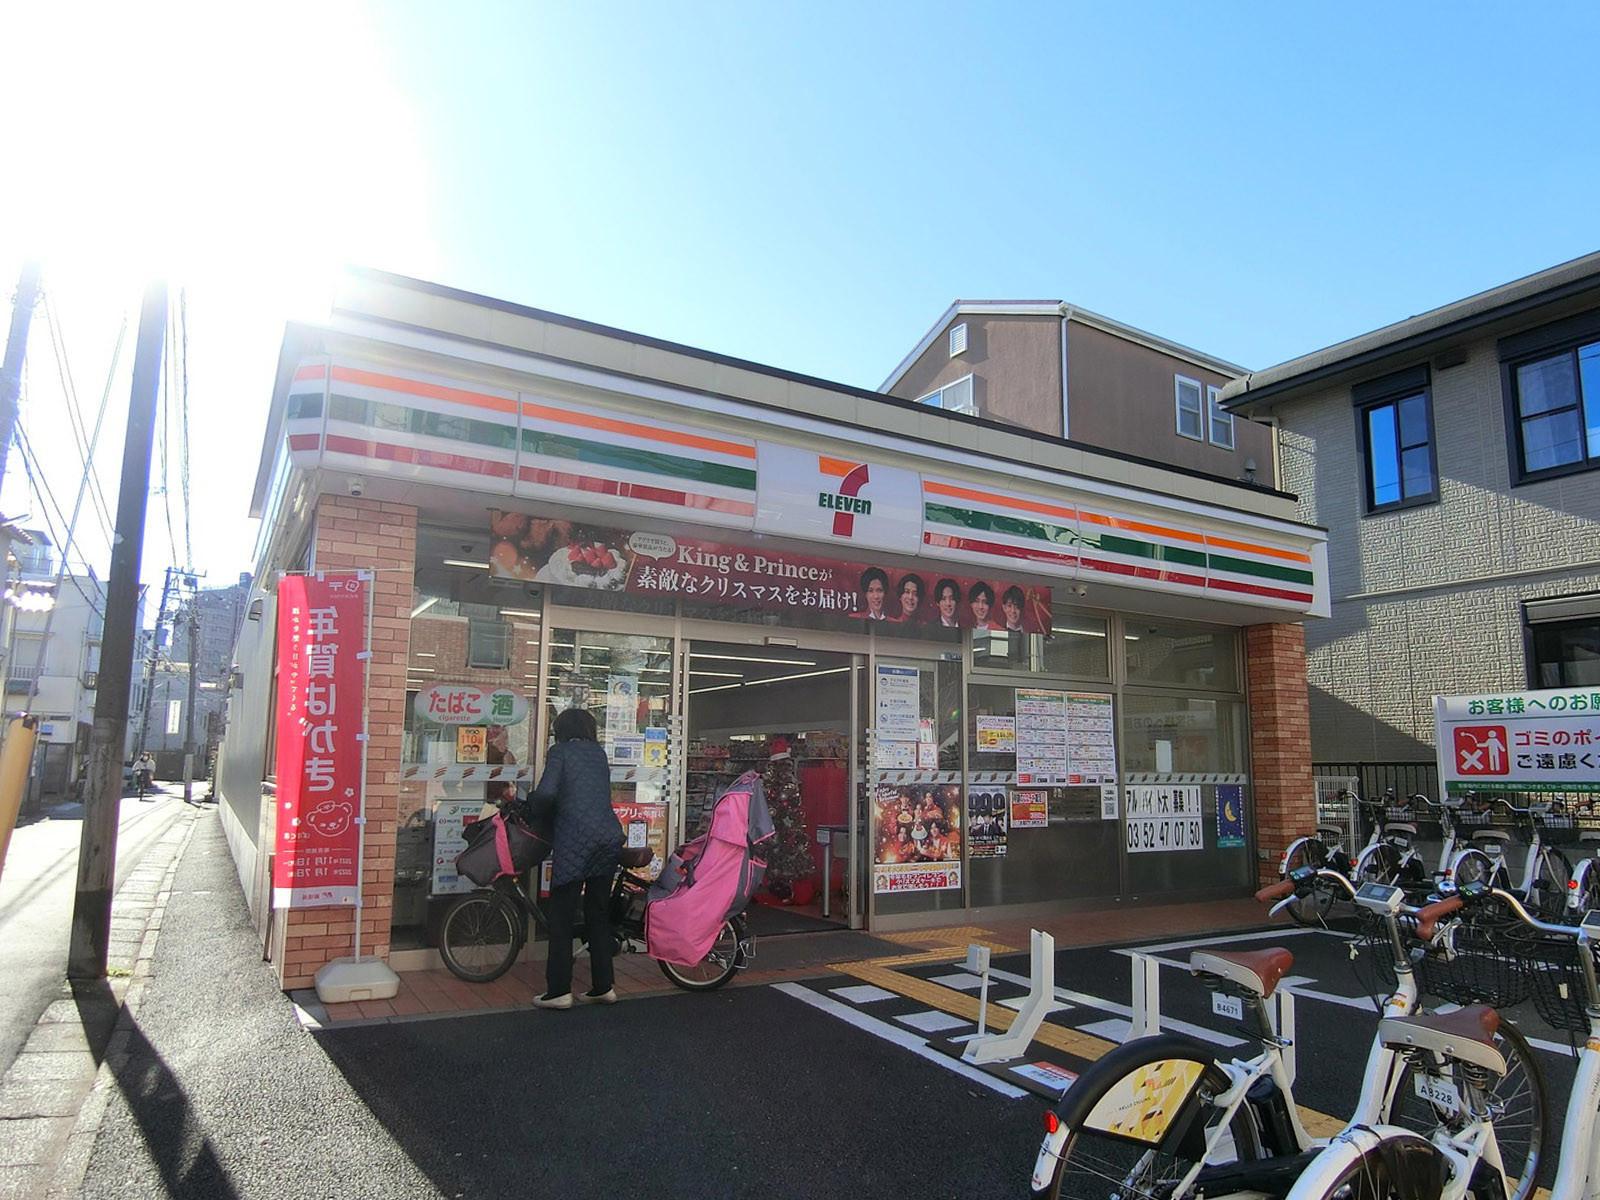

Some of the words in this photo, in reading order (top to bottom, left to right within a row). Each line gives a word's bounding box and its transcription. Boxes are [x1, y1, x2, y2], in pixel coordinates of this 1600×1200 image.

[677, 544, 732, 574] King
[734, 553, 750, 572] &
[753, 555, 833, 583] Princeが
[636, 565, 858, 613] 素敵なクリスマスをお届け!
[429, 690, 482, 714] たばこ
[491, 693, 515, 716] 酒
[438, 714, 471, 722] cigarette
[1515, 728, 1600, 747] ゴミのポ
[1516, 752, 1600, 770] ご遠慮く
[1420, 1085, 1453, 1105] A8228
